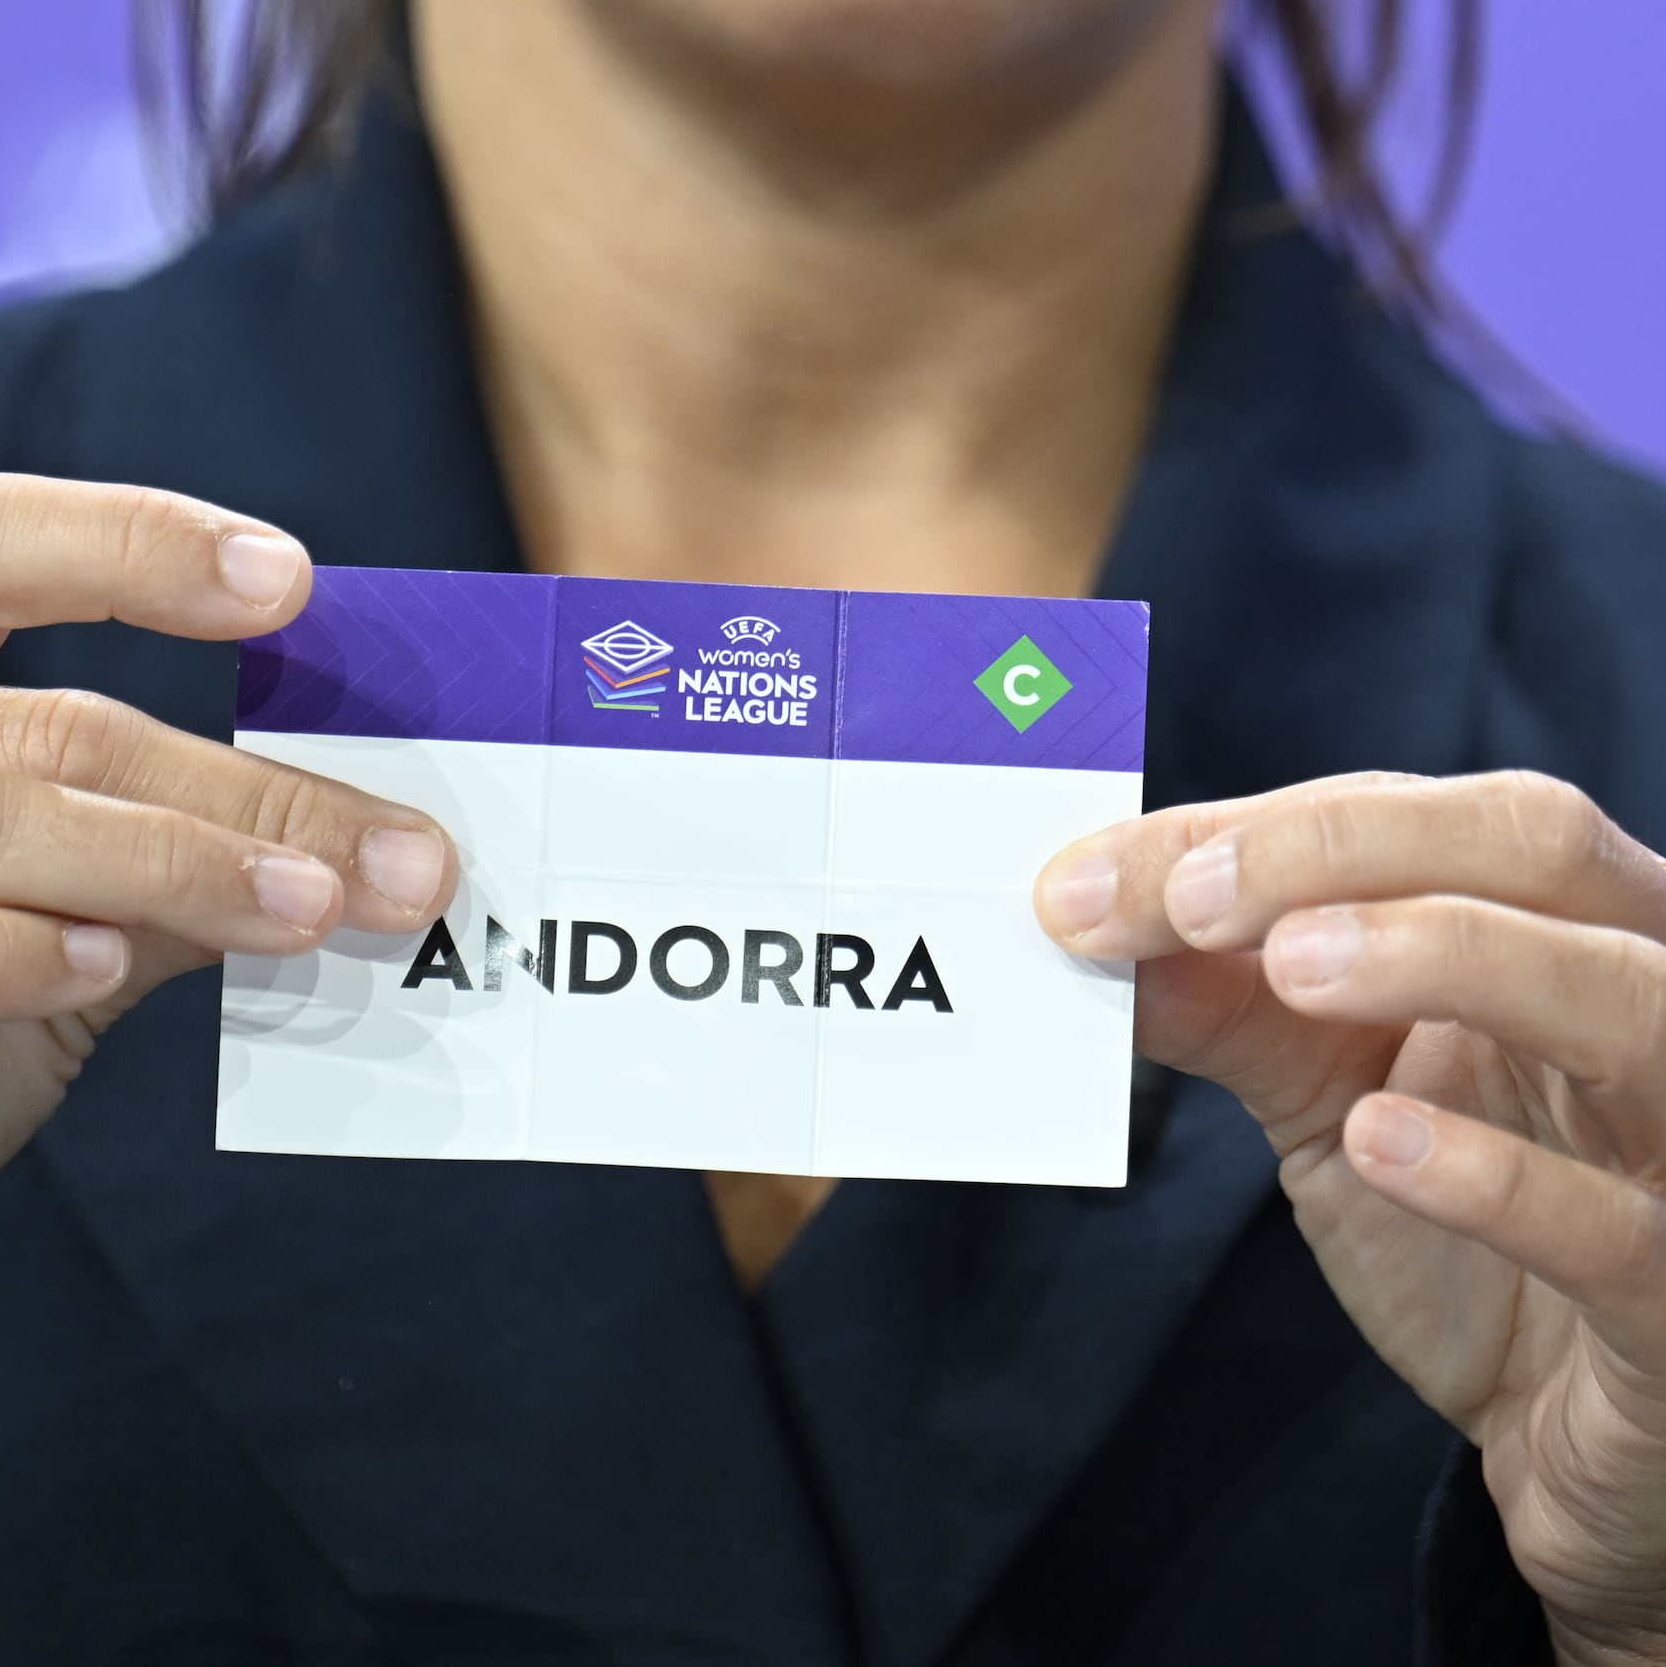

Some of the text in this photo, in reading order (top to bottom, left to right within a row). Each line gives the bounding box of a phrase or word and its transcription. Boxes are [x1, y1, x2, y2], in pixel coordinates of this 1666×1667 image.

[722, 620, 775, 643] UEFA
[698, 648, 801, 669] women's
[678, 668, 818, 700] NATIONS
[1003, 664, 1042, 706] C
[685, 696, 808, 726] LEAGUE
[400, 914, 955, 1014] ANDORRA
